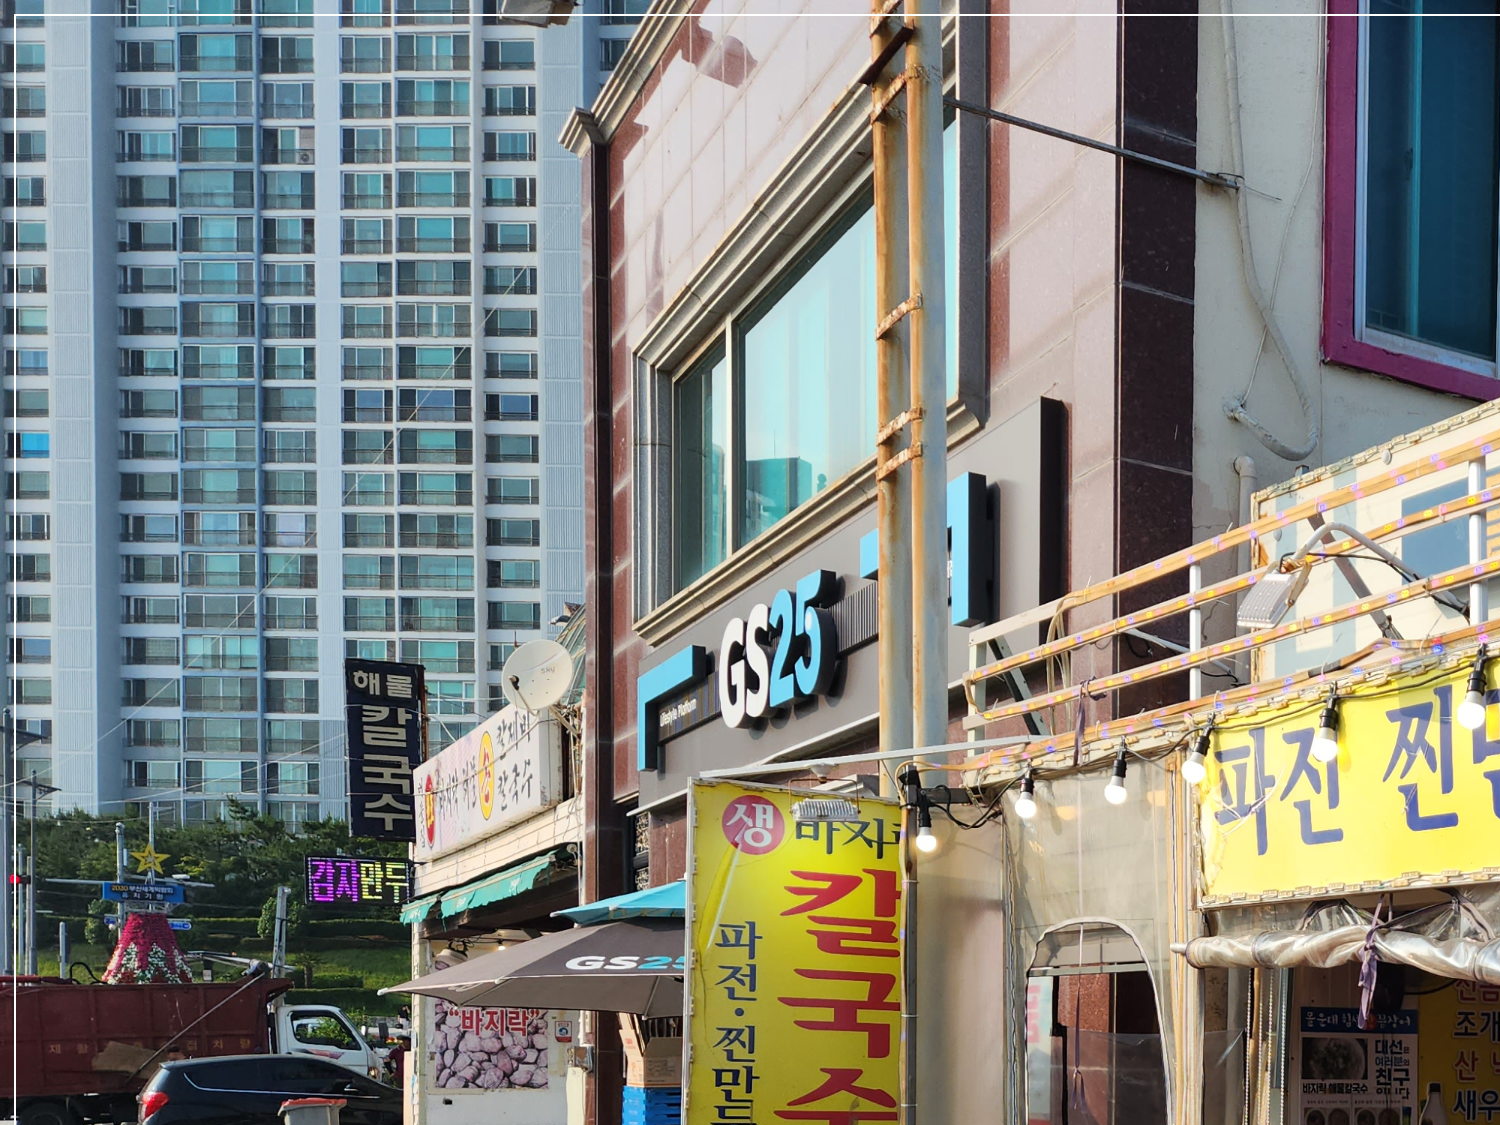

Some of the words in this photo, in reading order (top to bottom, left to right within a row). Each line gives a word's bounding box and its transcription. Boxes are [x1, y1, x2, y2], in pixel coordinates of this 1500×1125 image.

[719, 570, 836, 728] GS25
[353, 669, 413, 699] 해물
[361, 704, 413, 831] 칼국수
[1214, 726, 1344, 856] 파전
[726, 803, 774, 847] 생
[1303, 1083, 1327, 1095] 바지락
[1376, 1069, 1410, 1086] 친구
